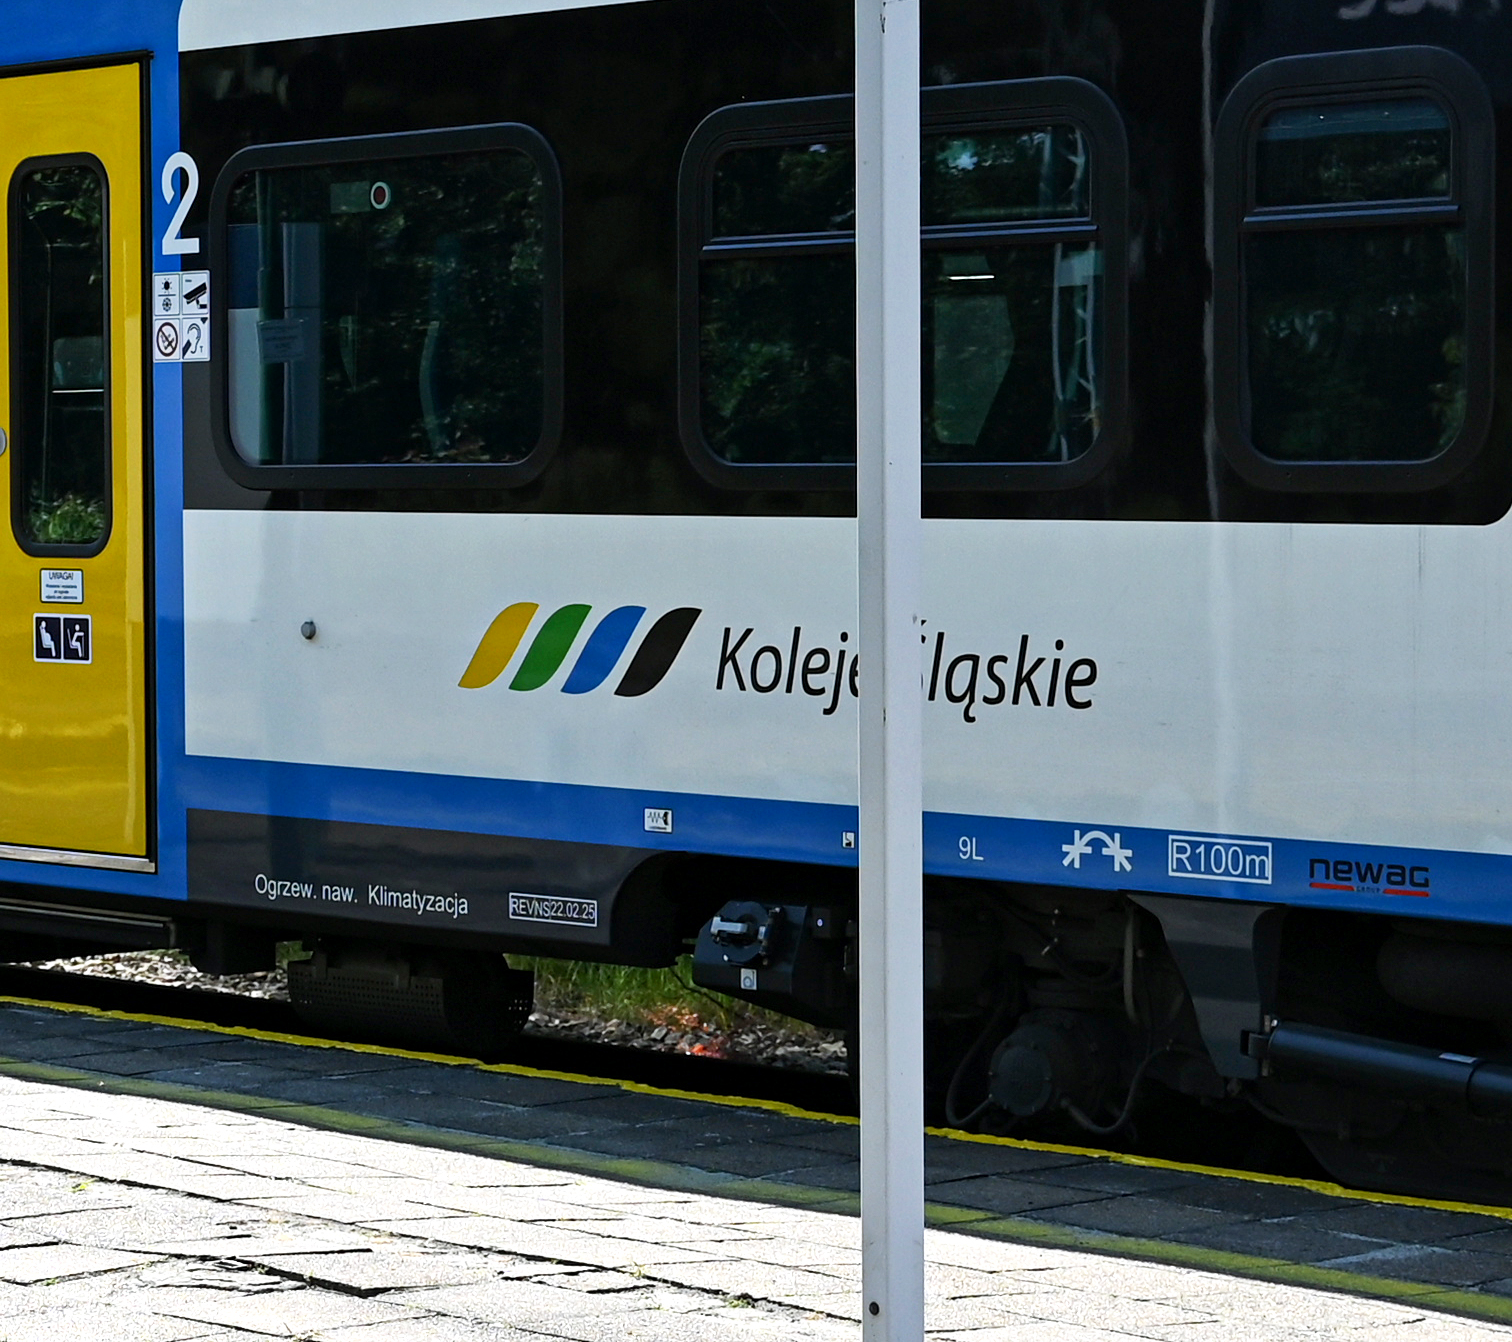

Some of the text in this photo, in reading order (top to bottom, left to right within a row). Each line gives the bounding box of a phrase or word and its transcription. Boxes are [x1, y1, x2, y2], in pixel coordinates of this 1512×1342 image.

[162, 151, 200, 255] 2
[921, 619, 1098, 724] ląskie
[958, 836, 984, 861] 9L
[1173, 841, 1269, 878] R100m
[255, 873, 469, 919] Ogrzew. naw. Klimatyzacja
[511, 898, 534, 917] REV
[550, 900, 596, 921] 22.02.25
